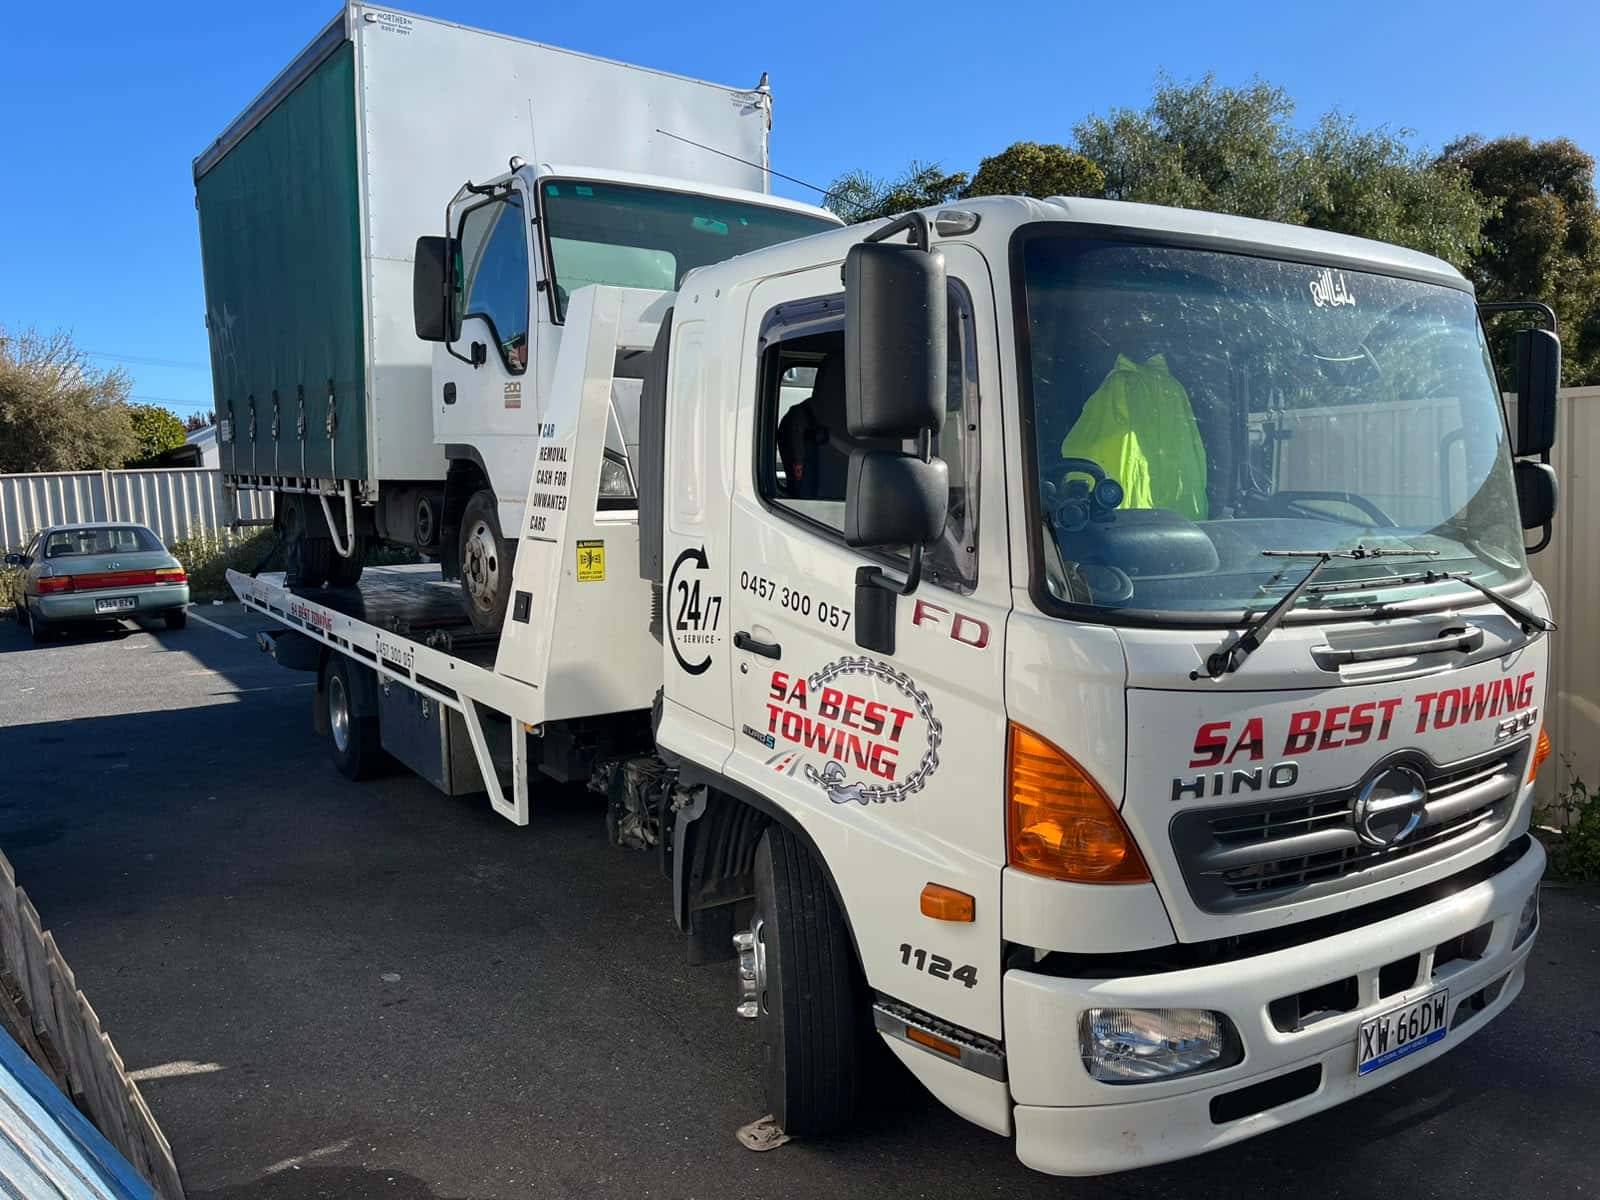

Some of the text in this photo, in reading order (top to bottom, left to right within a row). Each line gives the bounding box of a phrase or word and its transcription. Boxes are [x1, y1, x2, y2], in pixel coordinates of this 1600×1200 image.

[543, 423, 555, 438] CAR
[539, 447, 567, 462] REMOVAL
[536, 469, 567, 486] CASH FOR
[529, 515, 546, 531] CARS
[534, 492, 567, 511] UNWANTED
[676, 579, 722, 631] 24/7
[741, 571, 851, 632] 0457 300 057
[683, 634, 715, 645] SERVICE
[912, 599, 990, 649] FD
[769, 671, 914, 744] SA BEST
[1188, 671, 1536, 769] SA BEST TOWING
[766, 703, 900, 781] TOWING
[1171, 761, 1299, 801] HINO
[900, 943, 978, 989] 1124
